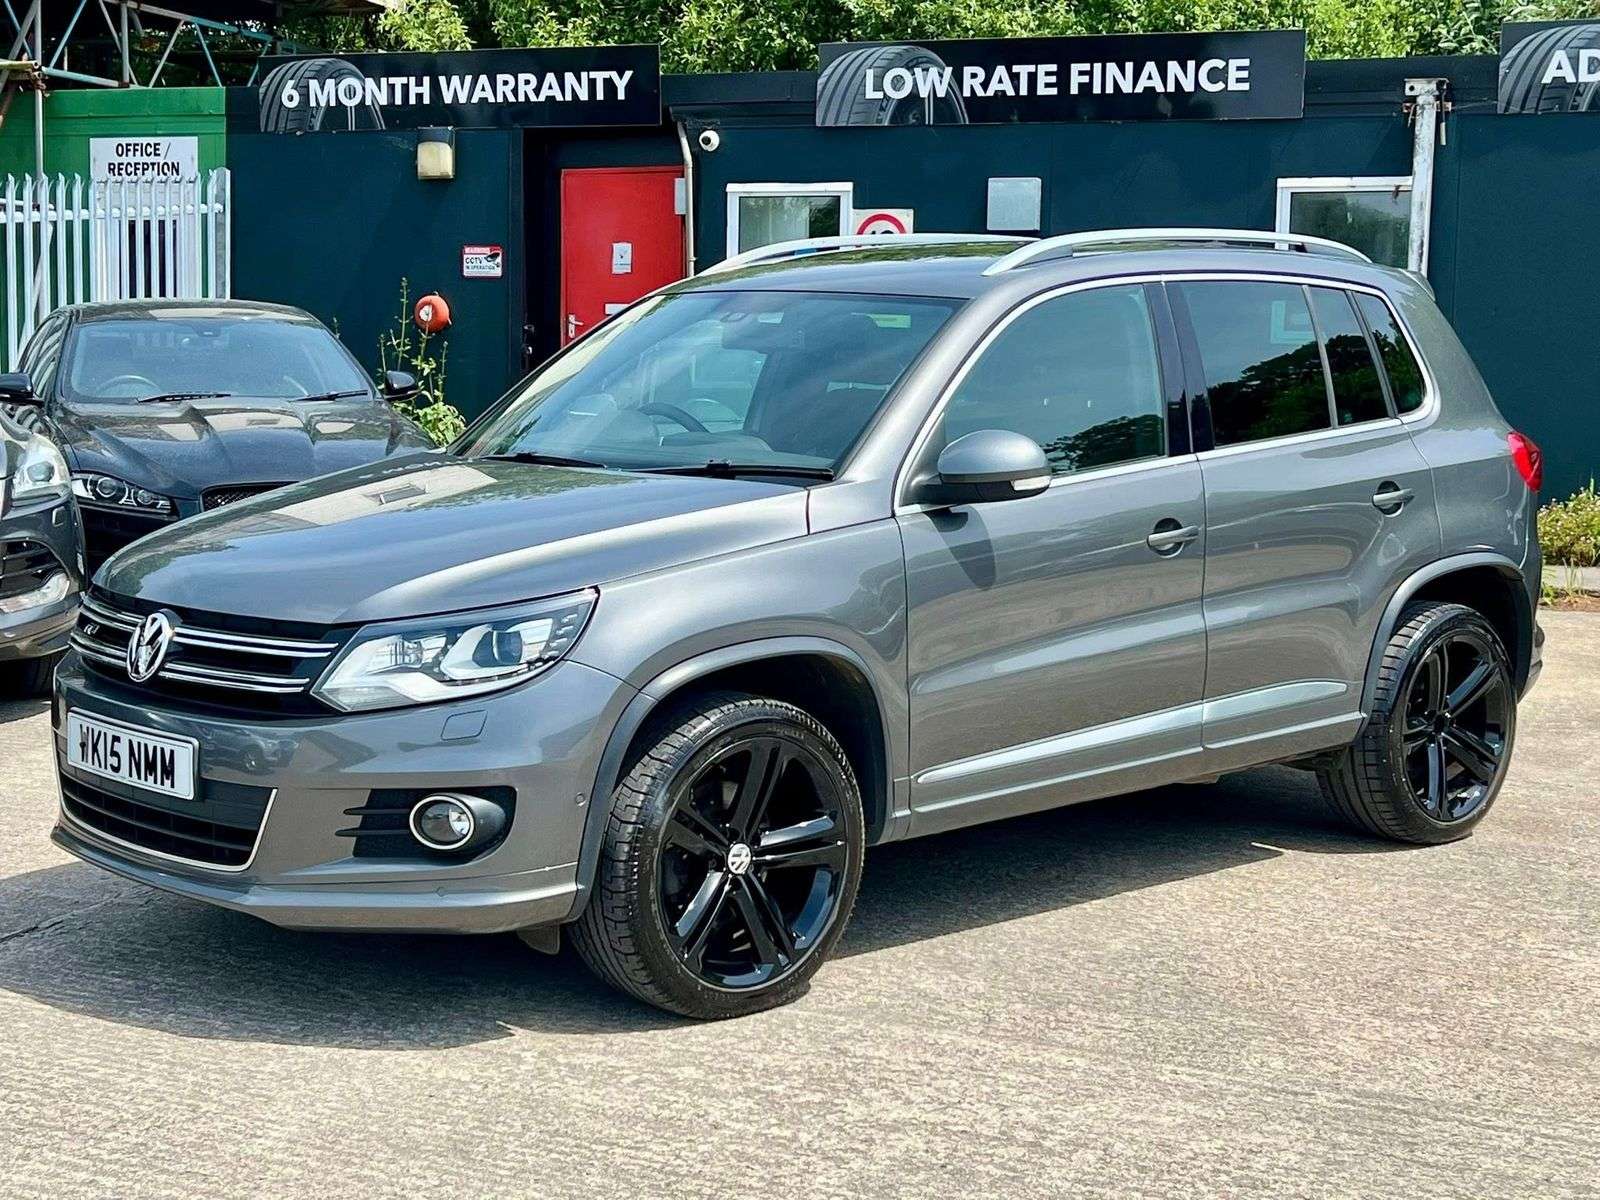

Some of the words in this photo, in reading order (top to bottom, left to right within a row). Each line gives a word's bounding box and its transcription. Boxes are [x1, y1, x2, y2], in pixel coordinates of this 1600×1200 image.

[864, 66, 953, 100] LOW
[962, 64, 1058, 97] RATE
[1070, 58, 1250, 95] FINANCE
[1541, 49, 1600, 84] AD
[281, 79, 300, 108] 6
[308, 77, 430, 107] MONTH
[438, 70, 634, 104] WARRANTY
[107, 161, 180, 177] RECEPTION
[79, 723, 121, 774] WK15
[128, 738, 175, 789] NMM
